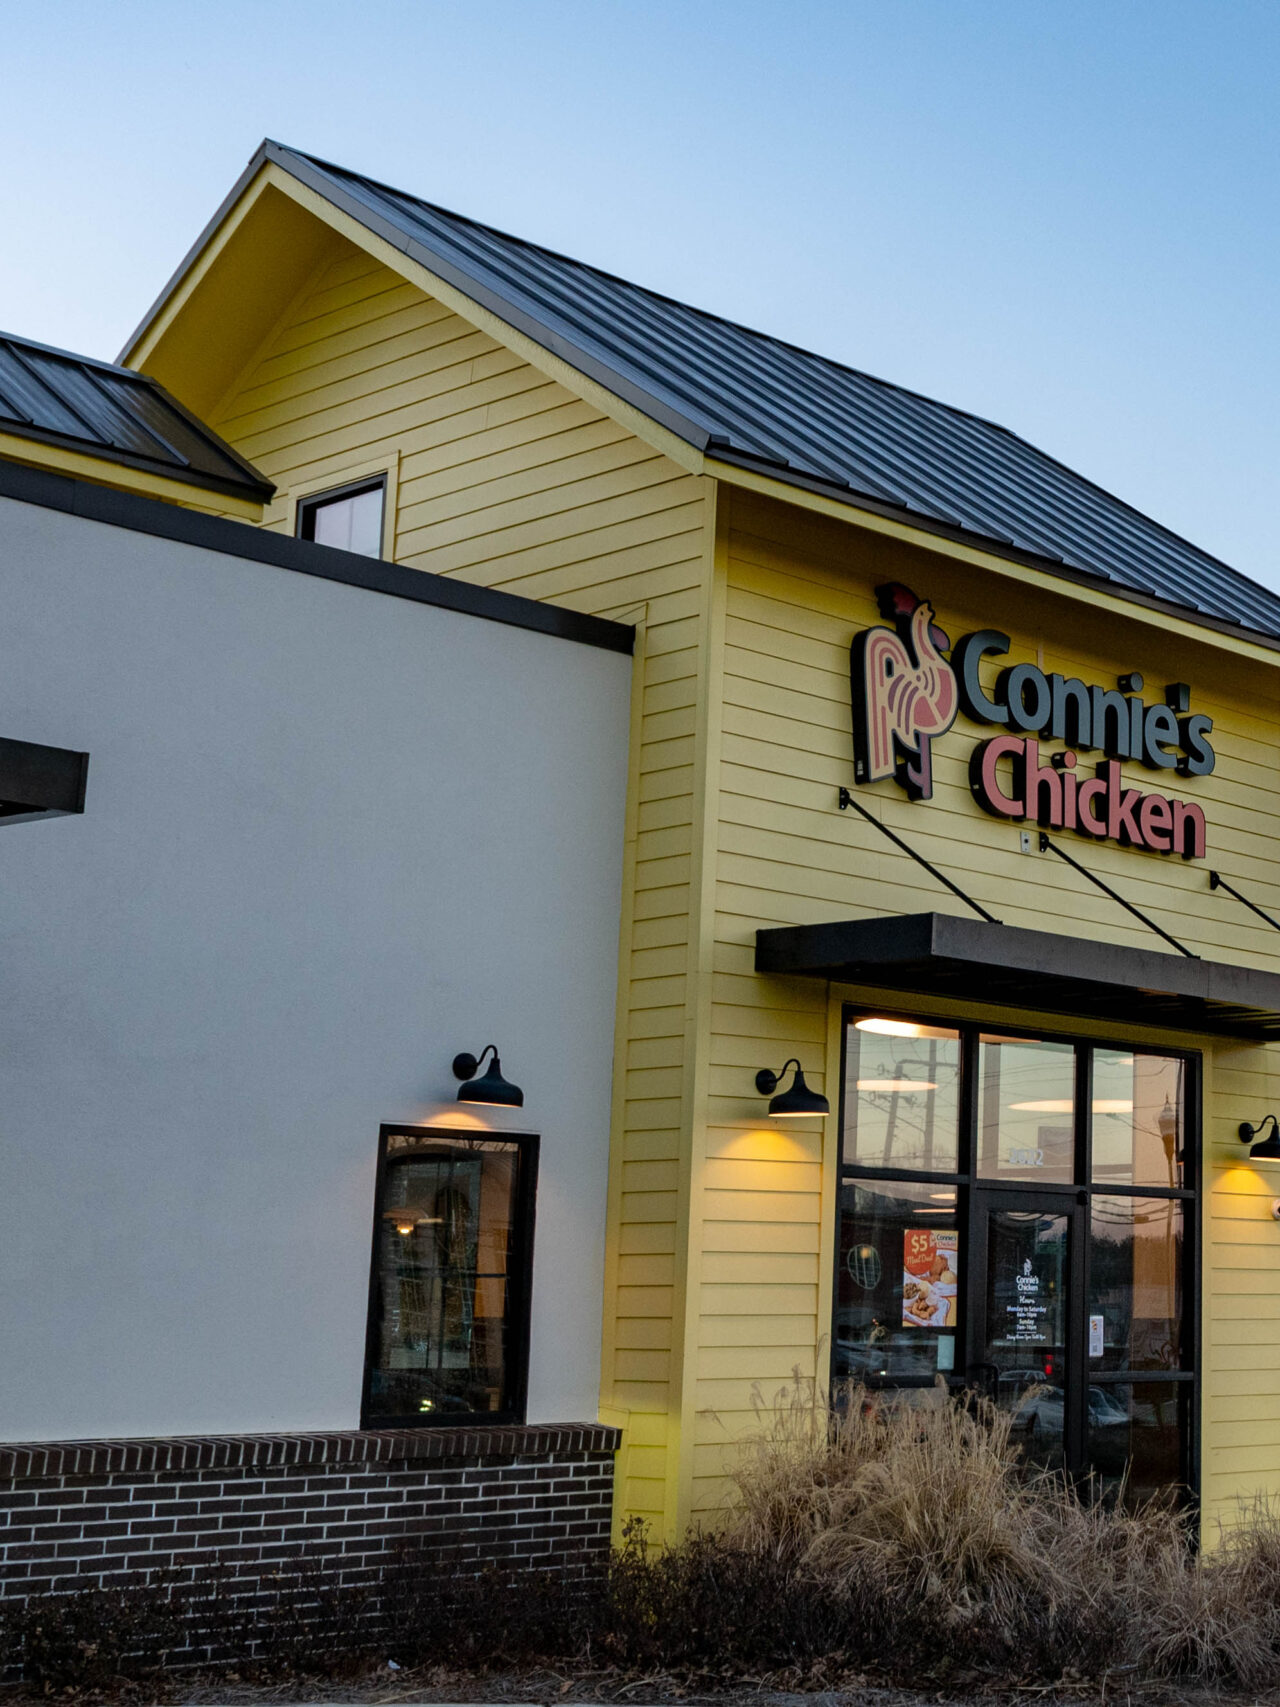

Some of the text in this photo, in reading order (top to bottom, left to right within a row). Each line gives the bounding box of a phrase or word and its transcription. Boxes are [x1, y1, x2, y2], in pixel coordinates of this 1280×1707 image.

[956, 629, 1215, 777] Connie's
[977, 735, 1206, 859] Chicken
[911, 1234, 928, 1254] $5
